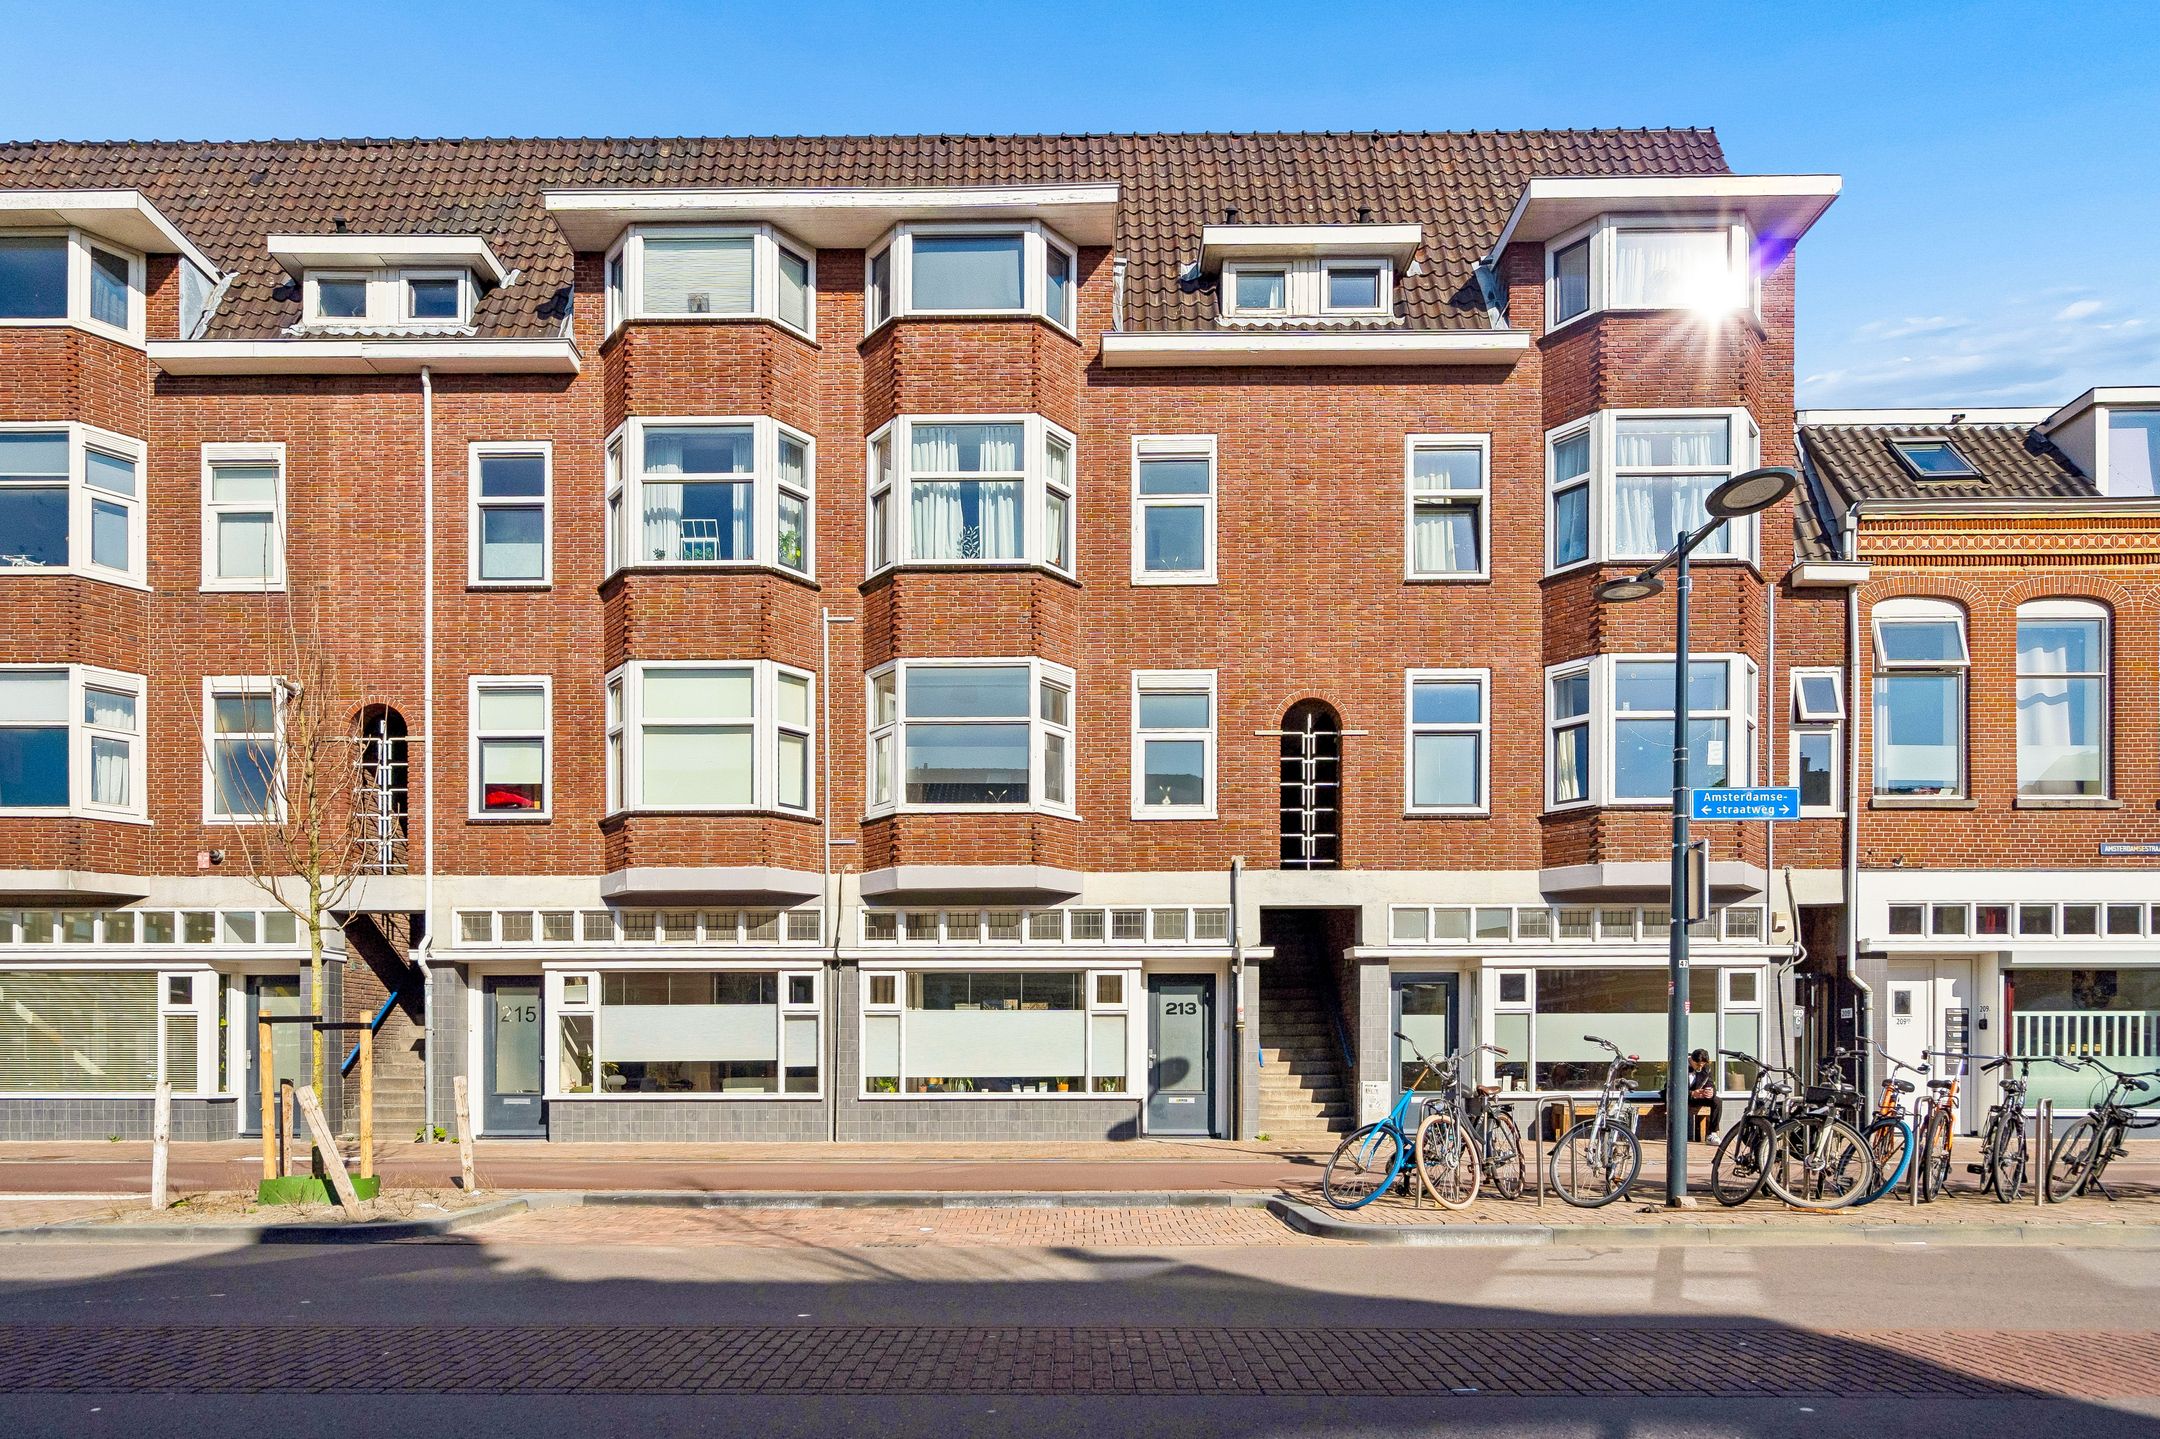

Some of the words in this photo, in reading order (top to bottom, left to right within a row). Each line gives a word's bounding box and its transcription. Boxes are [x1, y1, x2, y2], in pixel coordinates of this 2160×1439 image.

[1703, 792, 1788, 802] Amsterdamse-
[1716, 805, 1775, 816] straatweg
[501, 1005, 537, 1023] 215
[1165, 1002, 1197, 1015] 213
